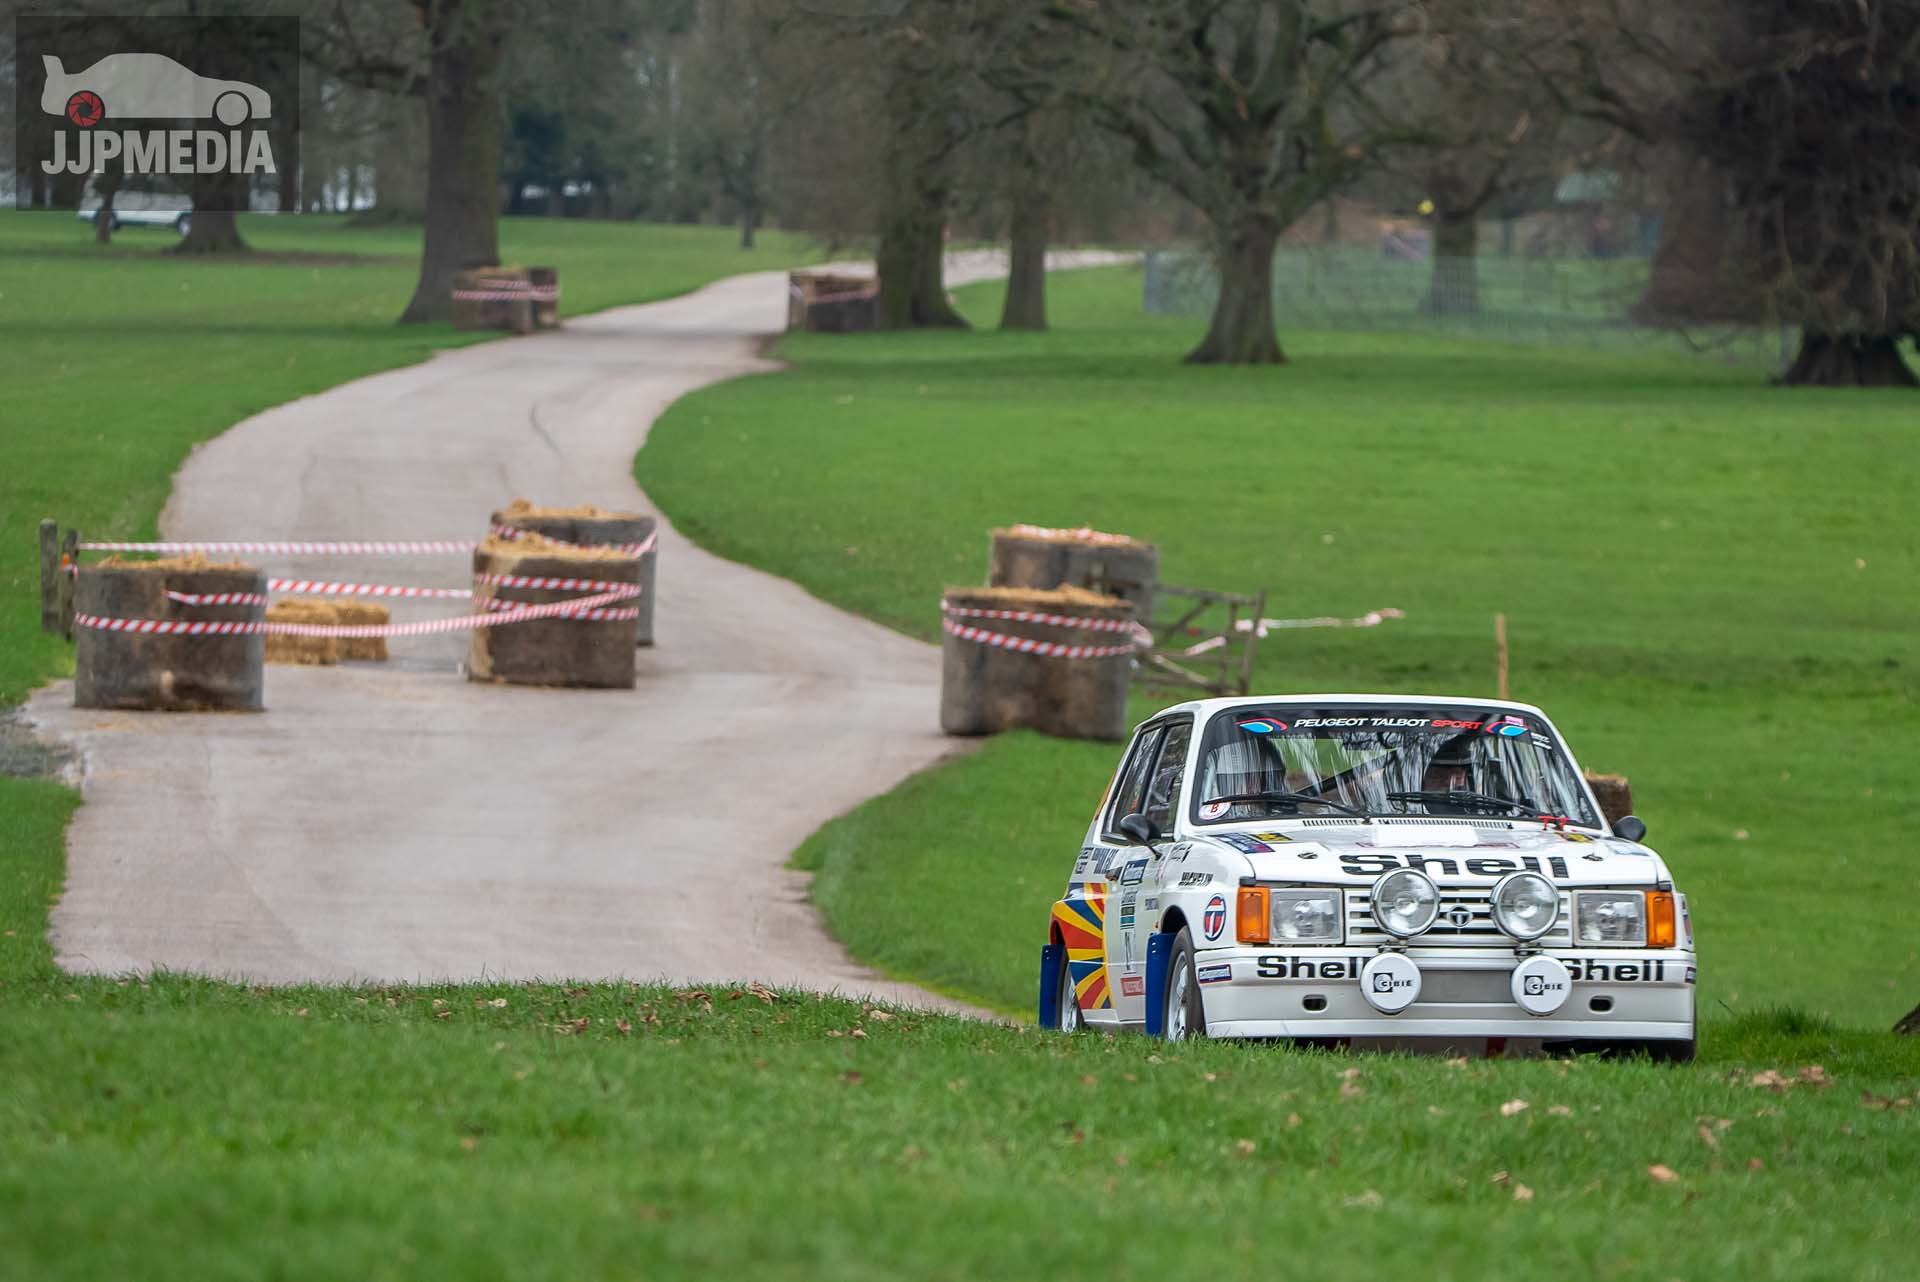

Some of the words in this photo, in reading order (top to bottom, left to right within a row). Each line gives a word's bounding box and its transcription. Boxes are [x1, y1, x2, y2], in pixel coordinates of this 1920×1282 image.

[1294, 718, 1369, 728] PEUGEOT
[1370, 718, 1430, 727] TALBOT
[1431, 719, 1482, 730] SPORT
[1339, 854, 1569, 879] Shell
